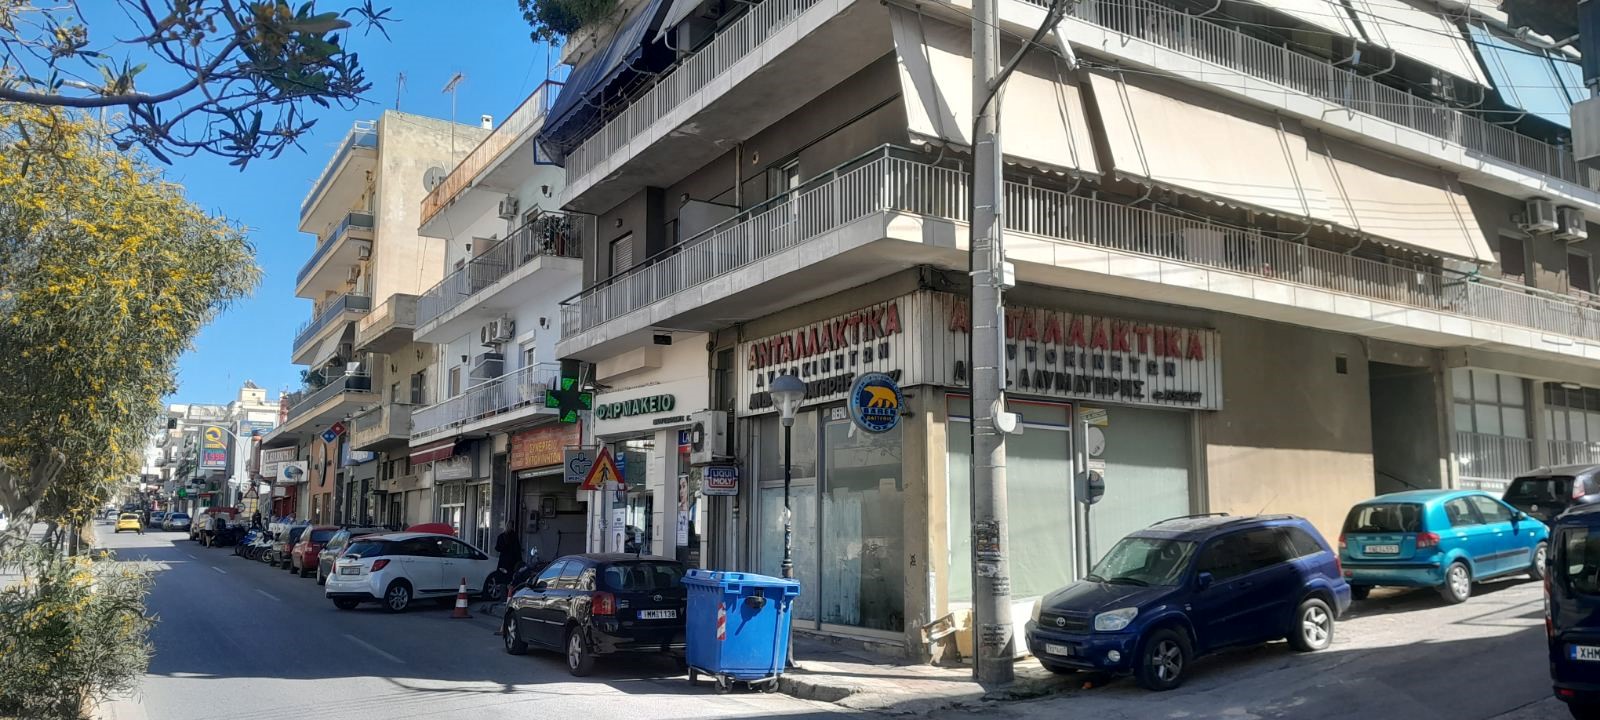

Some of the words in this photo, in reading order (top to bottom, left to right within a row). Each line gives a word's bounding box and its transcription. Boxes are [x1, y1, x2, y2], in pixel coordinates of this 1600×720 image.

[748, 302, 902, 371] ΑΝΤΑΛΛΑΚΤΙΚΑ
[950, 299, 1204, 362] ΑΤΑΛΛΑΚΤΙΚΑ
[1006, 344, 1176, 378] ΥΤΟΚΙΝΗΤΩΝ
[596, 394, 675, 420] ΦΑΡΜΑΚΕΙΟ
[712, 470, 732, 478] LIQUI
[712, 478, 732, 486] MOLY
